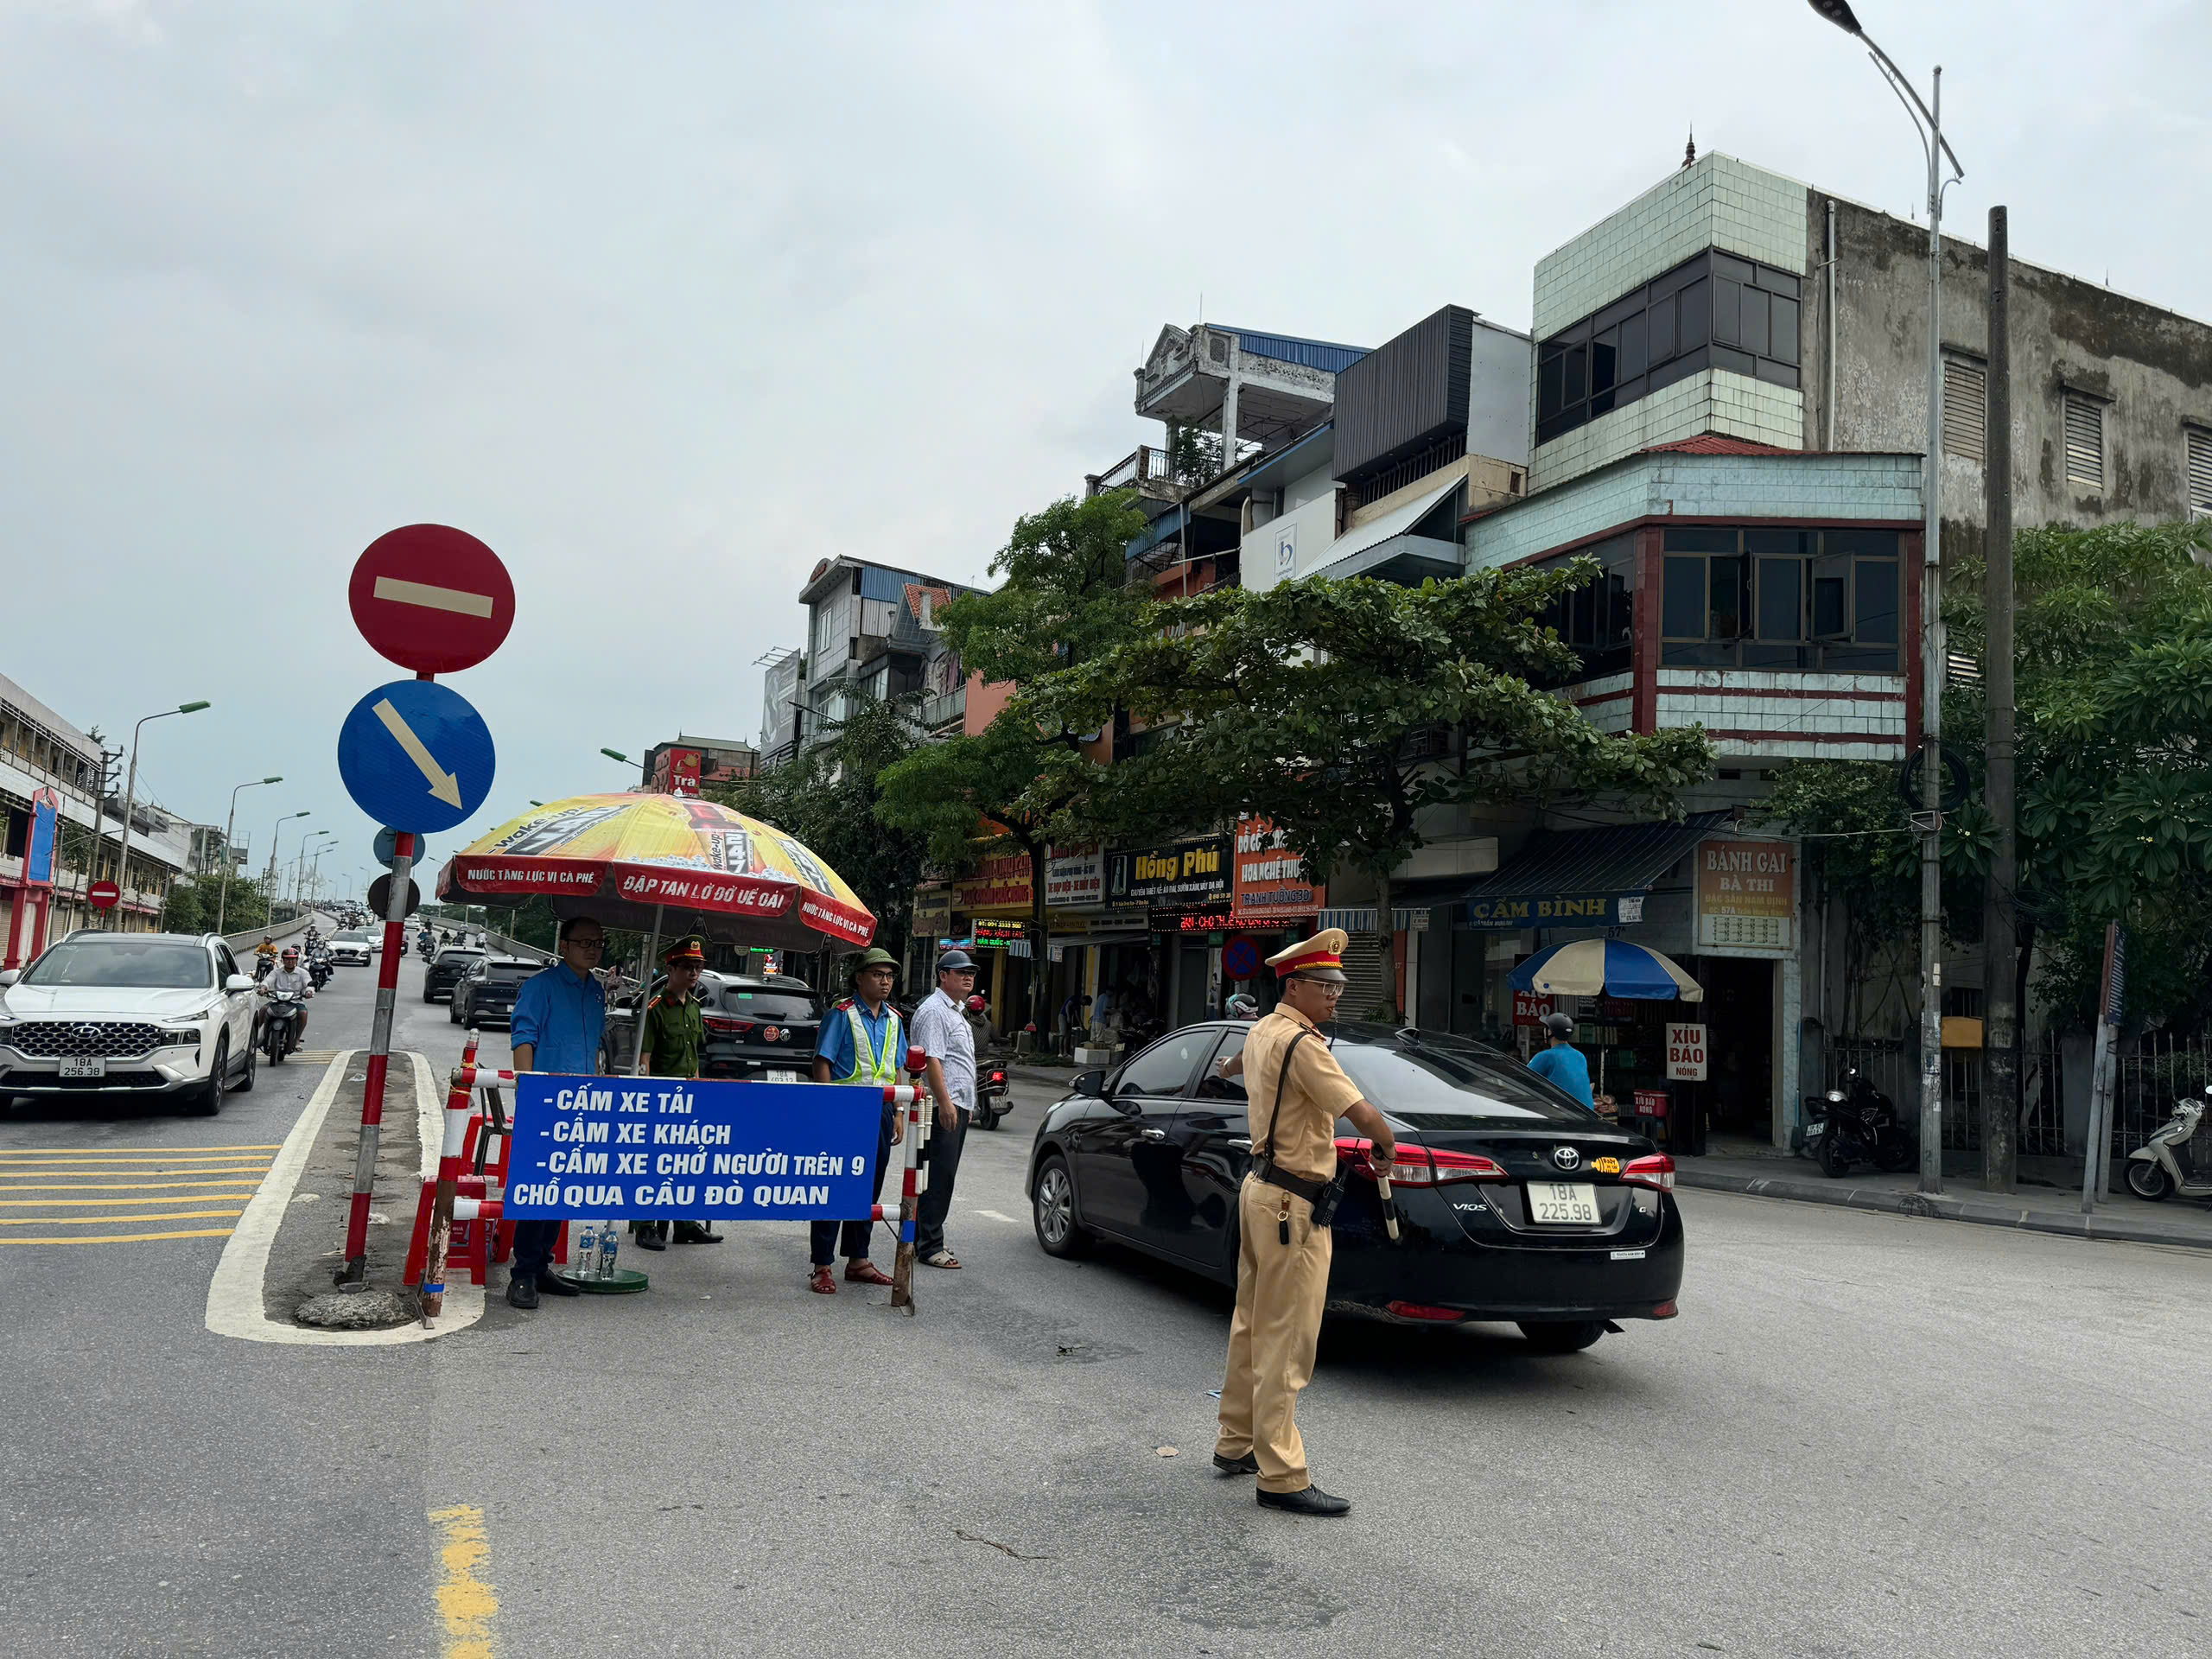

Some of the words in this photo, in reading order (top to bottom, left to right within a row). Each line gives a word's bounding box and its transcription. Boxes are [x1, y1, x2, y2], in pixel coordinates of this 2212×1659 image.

[673, 775, 696, 787] Trà
[1135, 850, 1179, 882] Hồng
[1183, 844, 1221, 877] Phú
[1707, 844, 1752, 872] BÁNH
[1757, 852, 1787, 873] GAI
[467, 868, 495, 880] NƯỚC
[498, 869, 524, 880] TĂNG
[526, 870, 545, 882] LỰC
[547, 872, 557, 883] VỊ
[575, 872, 594, 883] PHÊ
[1719, 874, 1742, 892] BÀ
[623, 875, 658, 893] ĐẬP
[659, 880, 690, 897] TAN
[1241, 892, 1266, 906] TRANH
[1537, 895, 1607, 918] BÌNH
[1745, 896, 1764, 905] NAM
[802, 901, 818, 915] NƯỚC
[843, 918, 849, 931] VỊ
[1516, 999, 1551, 1017] BÁO
[74, 1058, 92, 1066] 18A
[1669, 1046, 1704, 1064] BÁO
[64, 1067, 100, 1076] 256.38
[1676, 1065, 1698, 1077] NÓNG
[619, 1091, 651, 1113] XE
[658, 1085, 694, 1115] TẢI
[615, 1123, 647, 1144] XE
[653, 1119, 731, 1145] KHÁCH
[615, 1153, 649, 1175] XE
[656, 1145, 708, 1175] CHỞ
[712, 1147, 789, 1175] NGƯỜI
[793, 1151, 843, 1176] TRÊN
[851, 1155, 865, 1176] 9
[513, 1177, 560, 1206] CHỖ
[563, 1185, 625, 1208] QUA
[634, 1177, 696, 1206] CẦU
[704, 1179, 744, 1205] ĐÒ
[753, 1185, 830, 1207] QUAN
[1549, 1183, 1577, 1201] 18A
[1540, 1203, 1592, 1220] 225.98
